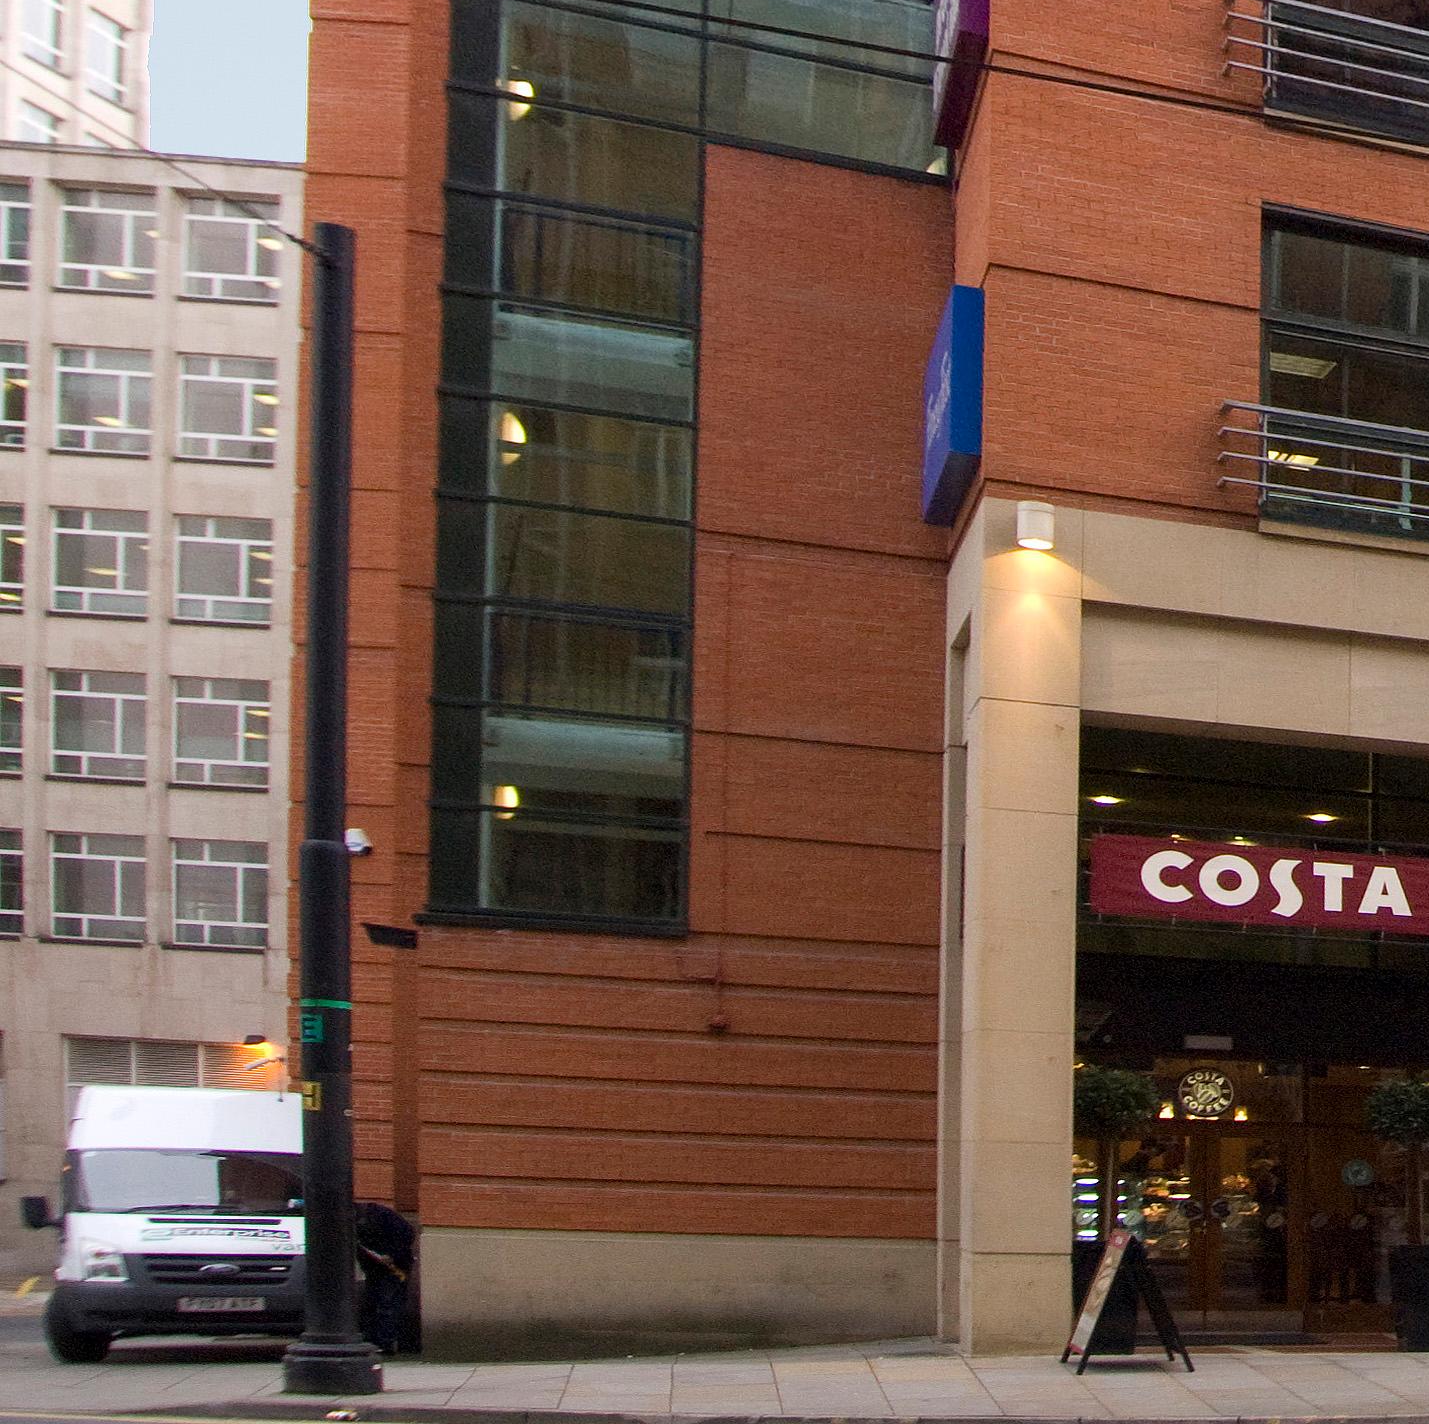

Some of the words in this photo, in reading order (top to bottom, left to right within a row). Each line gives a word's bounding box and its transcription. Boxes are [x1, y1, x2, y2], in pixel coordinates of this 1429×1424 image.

[1140, 849, 1413, 918] COSTA
[1187, 1072, 1225, 1086] COSTA
[1183, 1095, 1229, 1114] COFFEE
